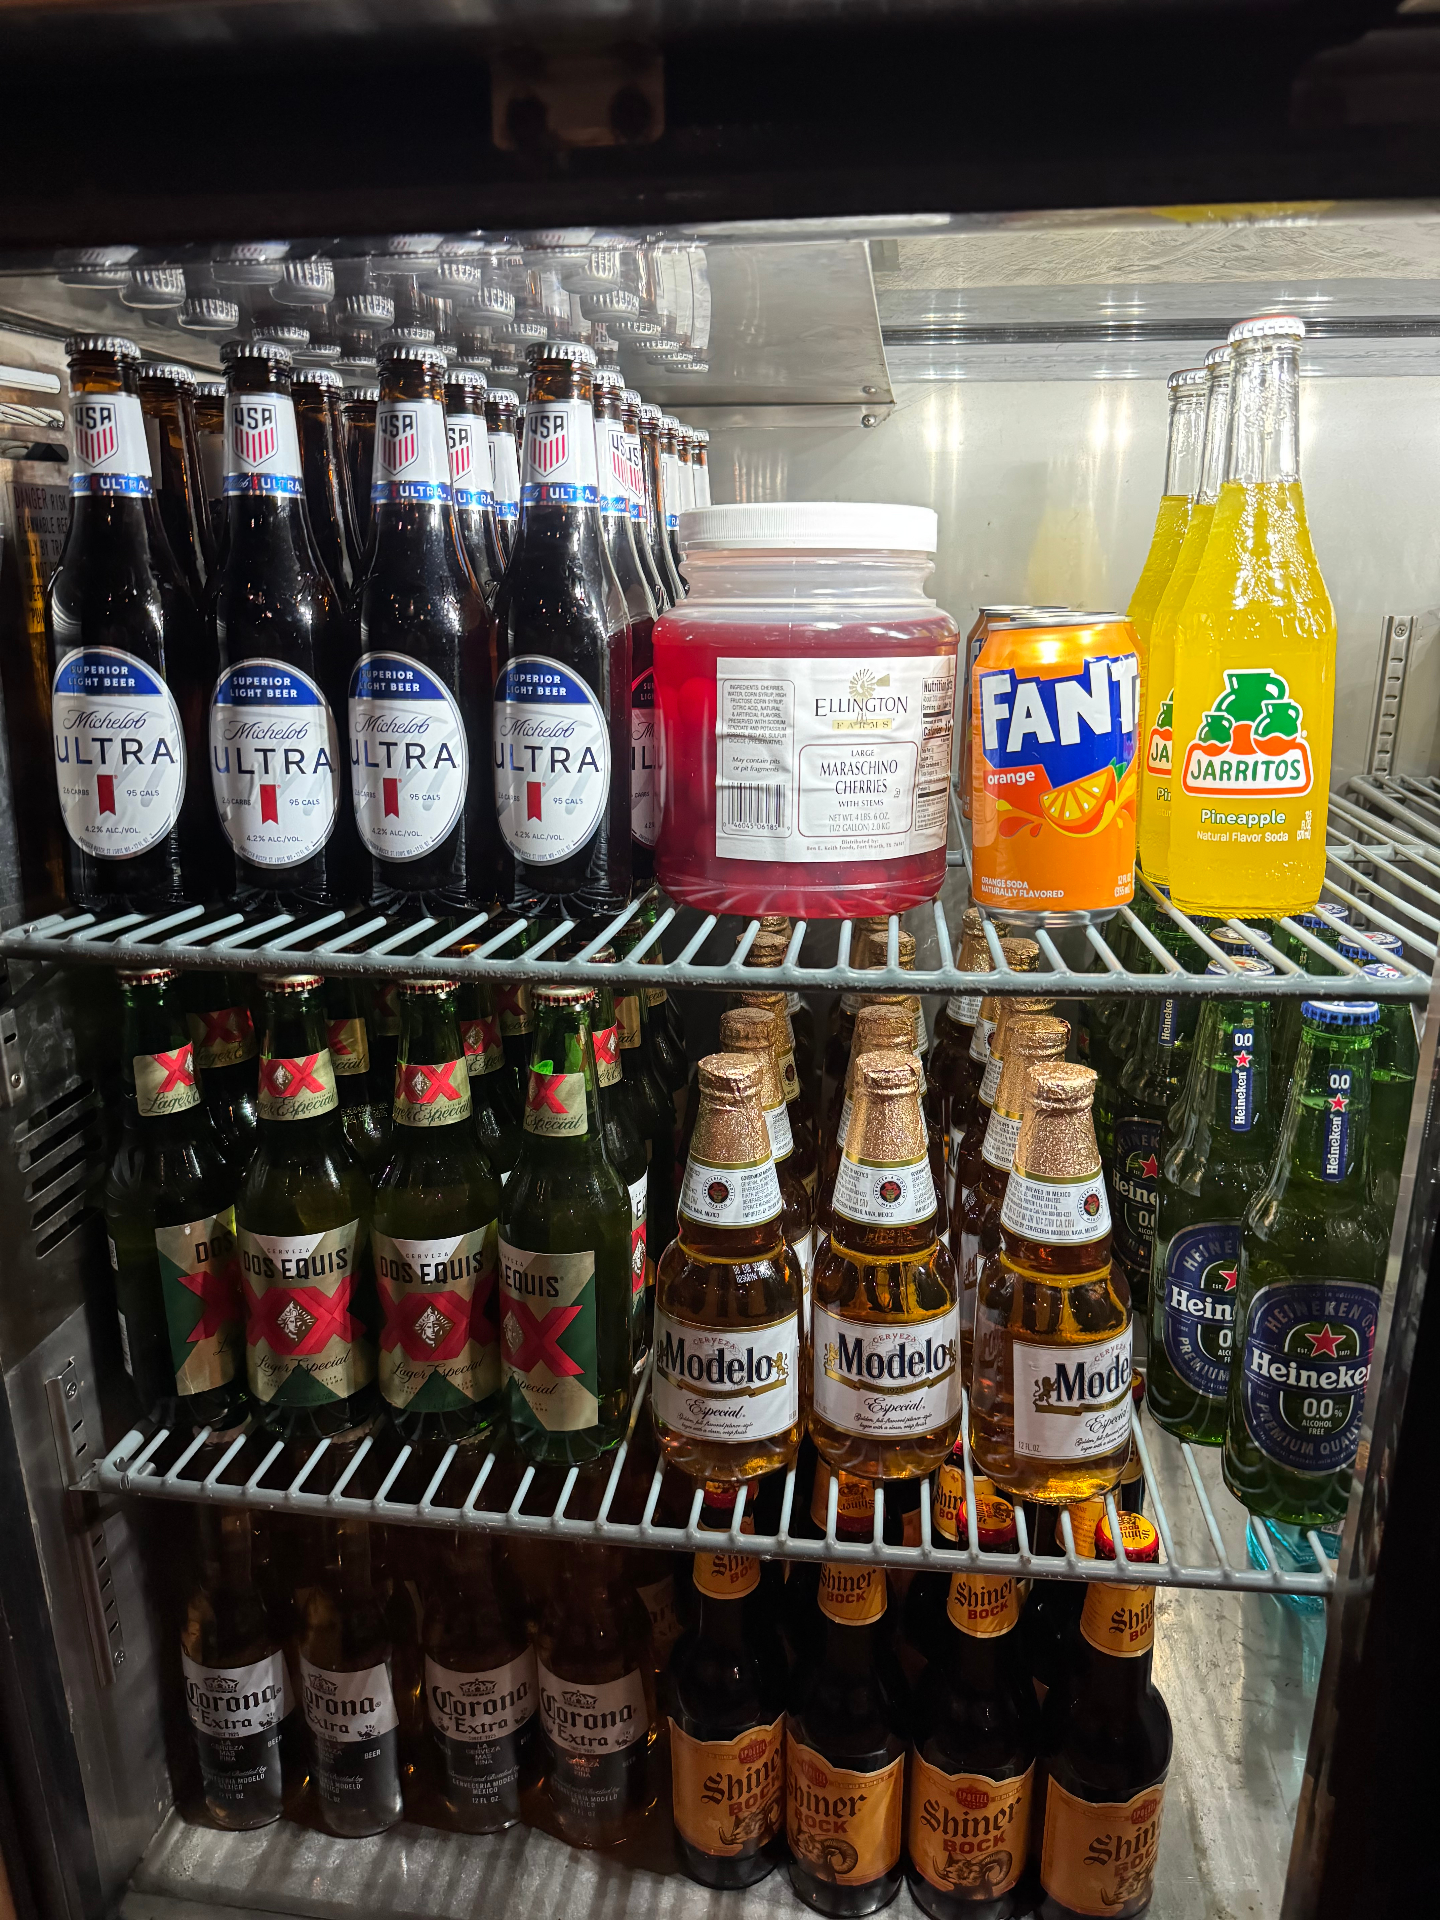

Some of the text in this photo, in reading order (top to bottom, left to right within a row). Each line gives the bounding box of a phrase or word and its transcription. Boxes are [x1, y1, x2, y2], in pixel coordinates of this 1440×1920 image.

[74, 407, 112, 430] USA
[234, 407, 272, 430] USA
[380, 414, 414, 438] USA
[530, 415, 564, 439] USA
[100, 478, 146, 491] ULTRA
[261, 477, 301, 491] ULTRA
[400, 485, 444, 498] ULTRA
[14, 486, 68, 512] DANGER RISK
[550, 487, 593, 501] ULTRA
[71, 665, 129, 675] SUPERIOR
[361, 670, 414, 680] SUPERIOR
[509, 674, 561, 684] SUPERIOR
[69, 677, 136, 687] LIGHT BEER
[233, 677, 291, 686] SUPERIOR
[359, 682, 420, 692] LIGHT BEER
[230, 689, 298, 698] LIGHT BEER
[507, 686, 567, 696] LIGHT BEER
[814, 696, 908, 717] ELLINGTON
[981, 656, 1140, 752] FANT
[63, 708, 149, 730] Michelob
[354, 713, 430, 734] Michelob
[500, 717, 578, 738] Michelob
[836, 720, 890, 729] FARMS
[223, 720, 310, 741] Michelob
[56, 735, 176, 765] ULTRA
[350, 738, 458, 769] ULTRA
[494, 741, 601, 774] ULTRA
[851, 749, 875, 757] LARGE
[214, 745, 334, 775] ULTRA
[732, 756, 745, 764] May
[819, 759, 898, 777] MARASCHINO
[987, 768, 1036, 786] orange
[1190, 758, 1301, 782] JARRITOS
[126, 789, 160, 797] 95 CALS
[835, 778, 888, 795] CHERRIES
[289, 798, 320, 806] 95 CALS
[409, 793, 441, 801] 95 CALS
[552, 797, 583, 806] 95 CALS
[861, 799, 884, 807] STEMS
[828, 812, 890, 822] NET WT. 4 LBS. 6 OZ.
[1200, 808, 1286, 828] Pineapple
[85, 825, 141, 835] 4.2% ALC./VOL.
[371, 827, 423, 838] 4.2% ALC./VOL.
[514, 830, 565, 842] 4.2% ALC./VOL.
[829, 821, 891, 833] (1/2 GALLON) 2.0 KG
[1197, 830, 1288, 842] Natural Flavor Soda
[246, 834, 303, 843] 4.2% ALC./VOL.
[981, 876, 1029, 889] ORANGE SODA
[981, 884, 1065, 898] NATURALLY FLAVORED
[1234, 1033, 1253, 1047] 0.0
[1329, 1074, 1350, 1089] 0.0
[276, 1090, 336, 1118] Especial
[1234, 1071, 1247, 1125] Heineken
[415, 1102, 472, 1126] Especial
[525, 1107, 581, 1132] Especial
[1327, 1116, 1342, 1175] Heineken
[1025, 1185, 1071, 1198] BREWED MEXICO
[1025, 1223, 1049, 1235] CERVECERIA
[195, 1230, 235, 1264] DOS
[405, 1251, 450, 1259] CERVEZA
[243, 1247, 348, 1280] DOS EQUIS
[380, 1251, 484, 1285] DOS EQUIS
[504, 1266, 560, 1298] EQUIS
[1264, 1300, 1363, 1334] HEINEKEN
[693, 1337, 735, 1349] CERVEZA
[873, 1332, 916, 1343] CERVEZA
[665, 1330, 772, 1384] Modelo
[838, 1332, 946, 1379] Modelo
[1094, 1343, 1126, 1362] CERVEZA
[1297, 1347, 1310, 1355] EST.
[255, 1354, 292, 1377] Lager
[391, 1358, 432, 1383] Lager
[685, 1399, 744, 1419] Especial
[864, 1396, 924, 1417] Especial
[1085, 1402, 1129, 1434] Especial
[1302, 1419, 1332, 1427] ALCOHOL
[1257, 1402, 1315, 1455] PREMIUM
[1320, 1411, 1362, 1454] QUALITY
[1309, 1427, 1324, 1435] FREE
[1018, 1441, 1024, 1450] 12
[821, 1566, 877, 1592] Shiner
[826, 1590, 867, 1604] BOCK
[954, 1577, 1012, 1608] Shiner
[967, 1601, 1008, 1620] BOCK
[184, 1675, 277, 1712] Corona
[432, 1682, 528, 1720] Corona
[541, 1687, 633, 1731] Corona
[201, 1711, 252, 1729] Extra
[307, 1703, 350, 1734] Extra
[454, 1715, 508, 1734] Extra
[267, 1735, 282, 1748] BEER
[557, 1723, 609, 1747] Extra
[364, 1749, 381, 1760] BEER
[452, 1778, 491, 1789] CERVECERIA
[701, 1748, 781, 1805] Shine
[472, 1786, 498, 1794] MEXICO
[729, 1775, 780, 1817] BOCK
[957, 1791, 988, 1803] SPOETZL
[795, 1808, 849, 1834] BOCK
[920, 1796, 1022, 1839] Shiner
[942, 1830, 1006, 1855] BOCK
